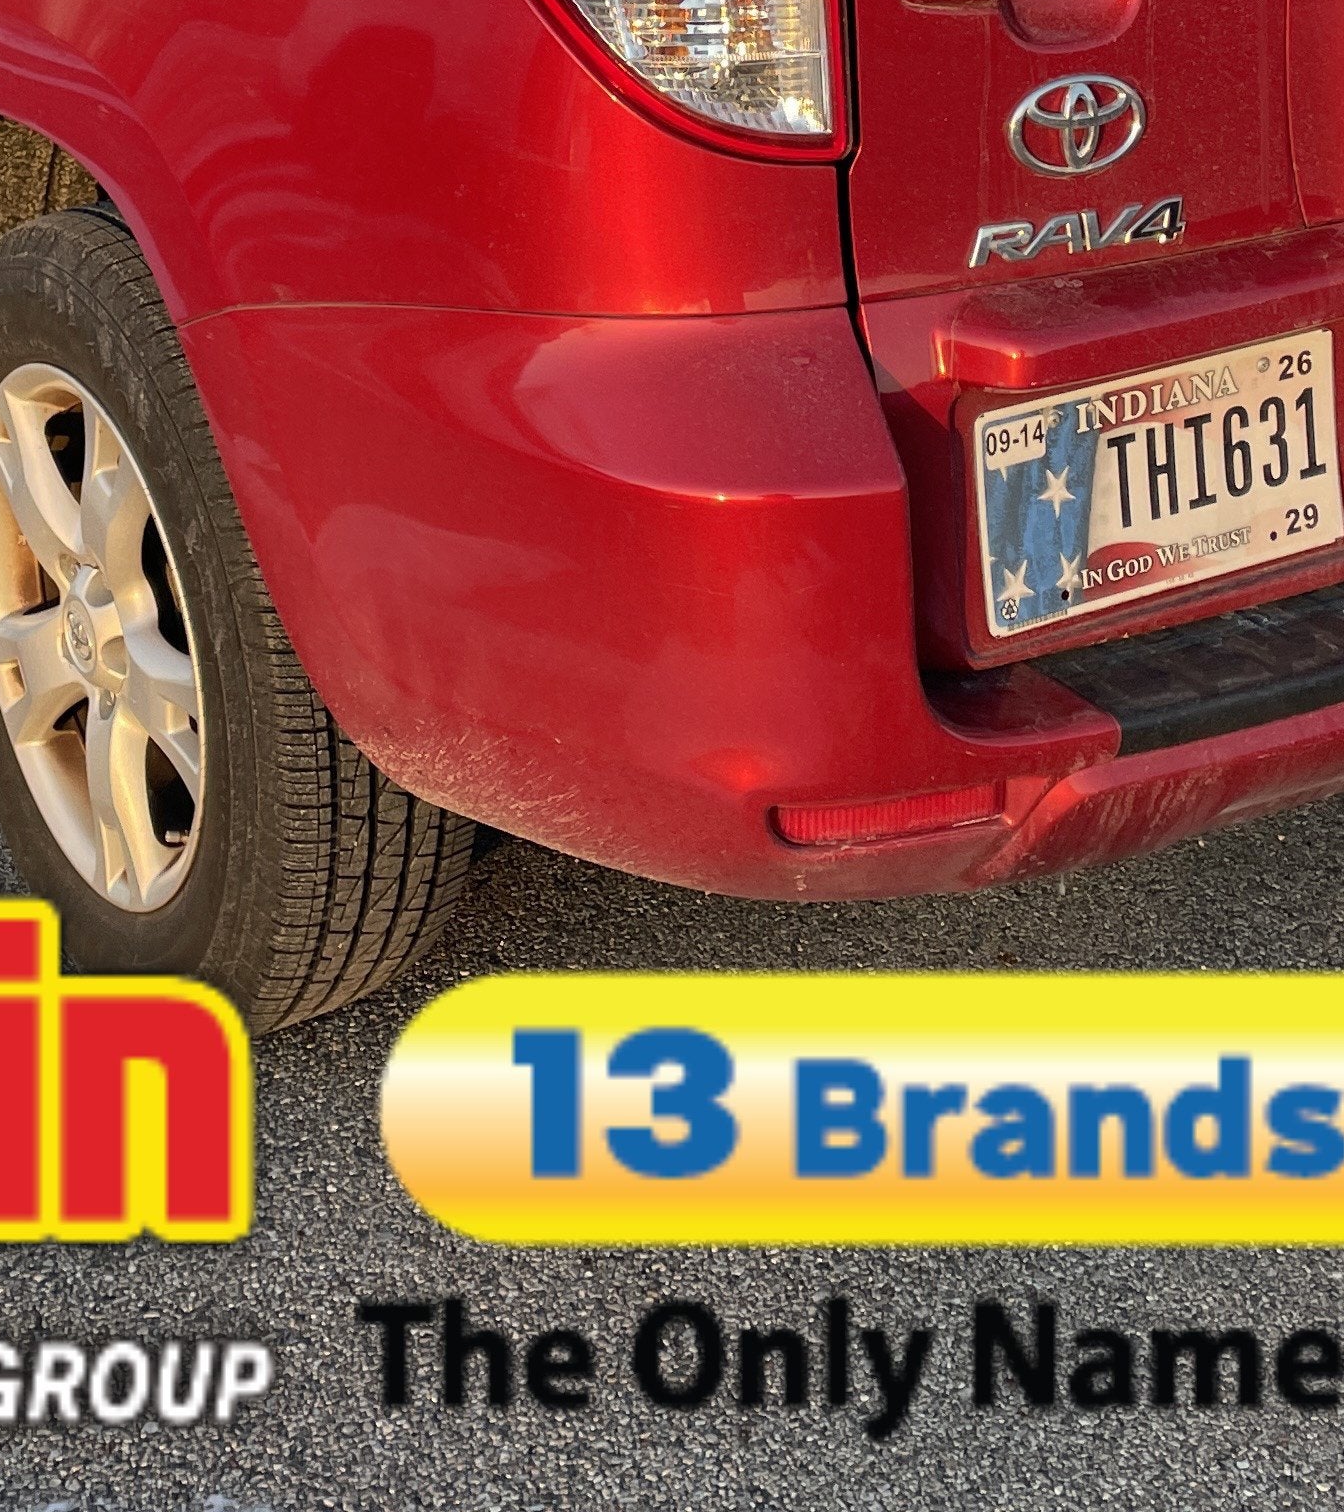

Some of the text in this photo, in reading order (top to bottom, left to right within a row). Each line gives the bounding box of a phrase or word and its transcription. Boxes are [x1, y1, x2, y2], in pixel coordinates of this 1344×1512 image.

[968, 194, 1186, 269] RAV4
[1076, 350, 1313, 435] INDIANA 26
[985, 420, 1045, 457] 09-14
[1107, 387, 1327, 530] THI631
[1285, 503, 1319, 536] 29
